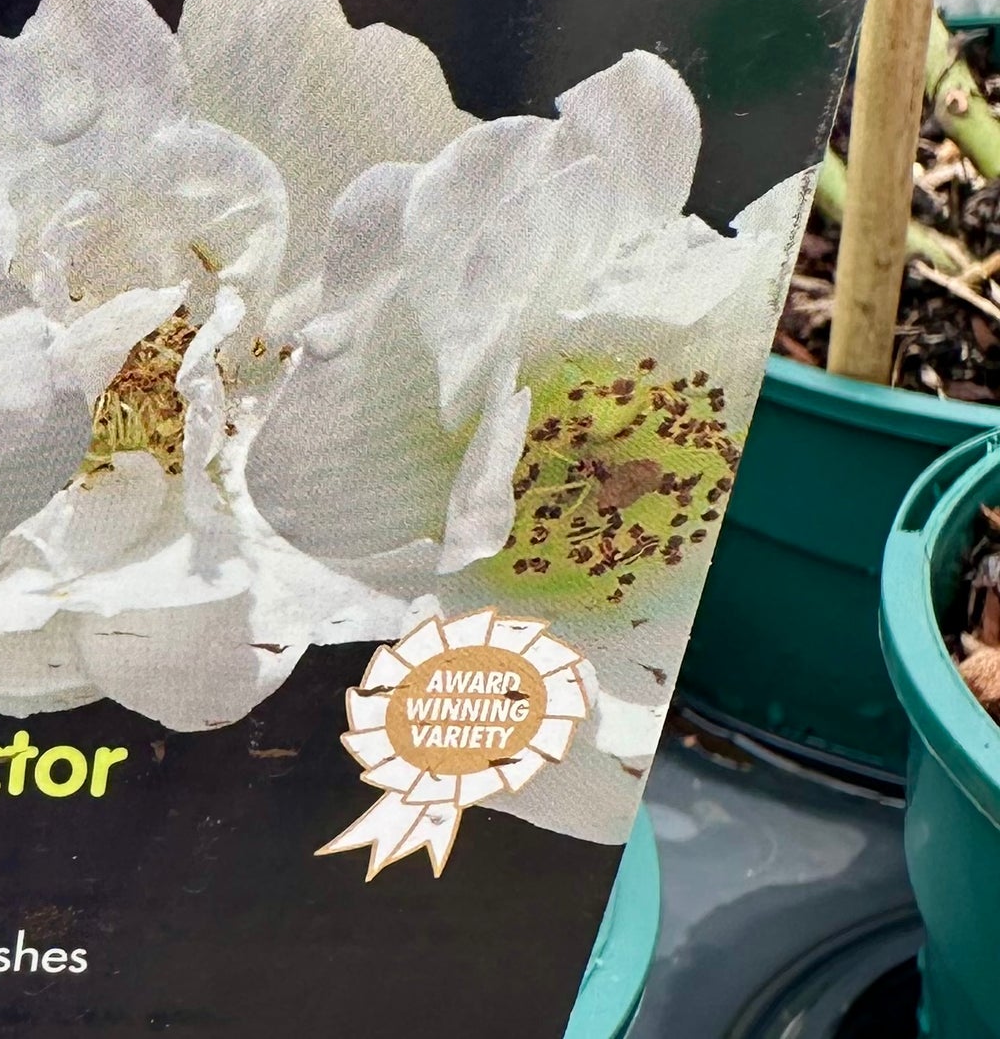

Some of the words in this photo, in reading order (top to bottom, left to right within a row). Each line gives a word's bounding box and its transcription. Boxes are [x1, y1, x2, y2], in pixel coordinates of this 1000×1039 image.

[426, 669, 521, 693] AWARD
[405, 697, 530, 723] WINNING
[411, 725, 515, 749] VARIETY
